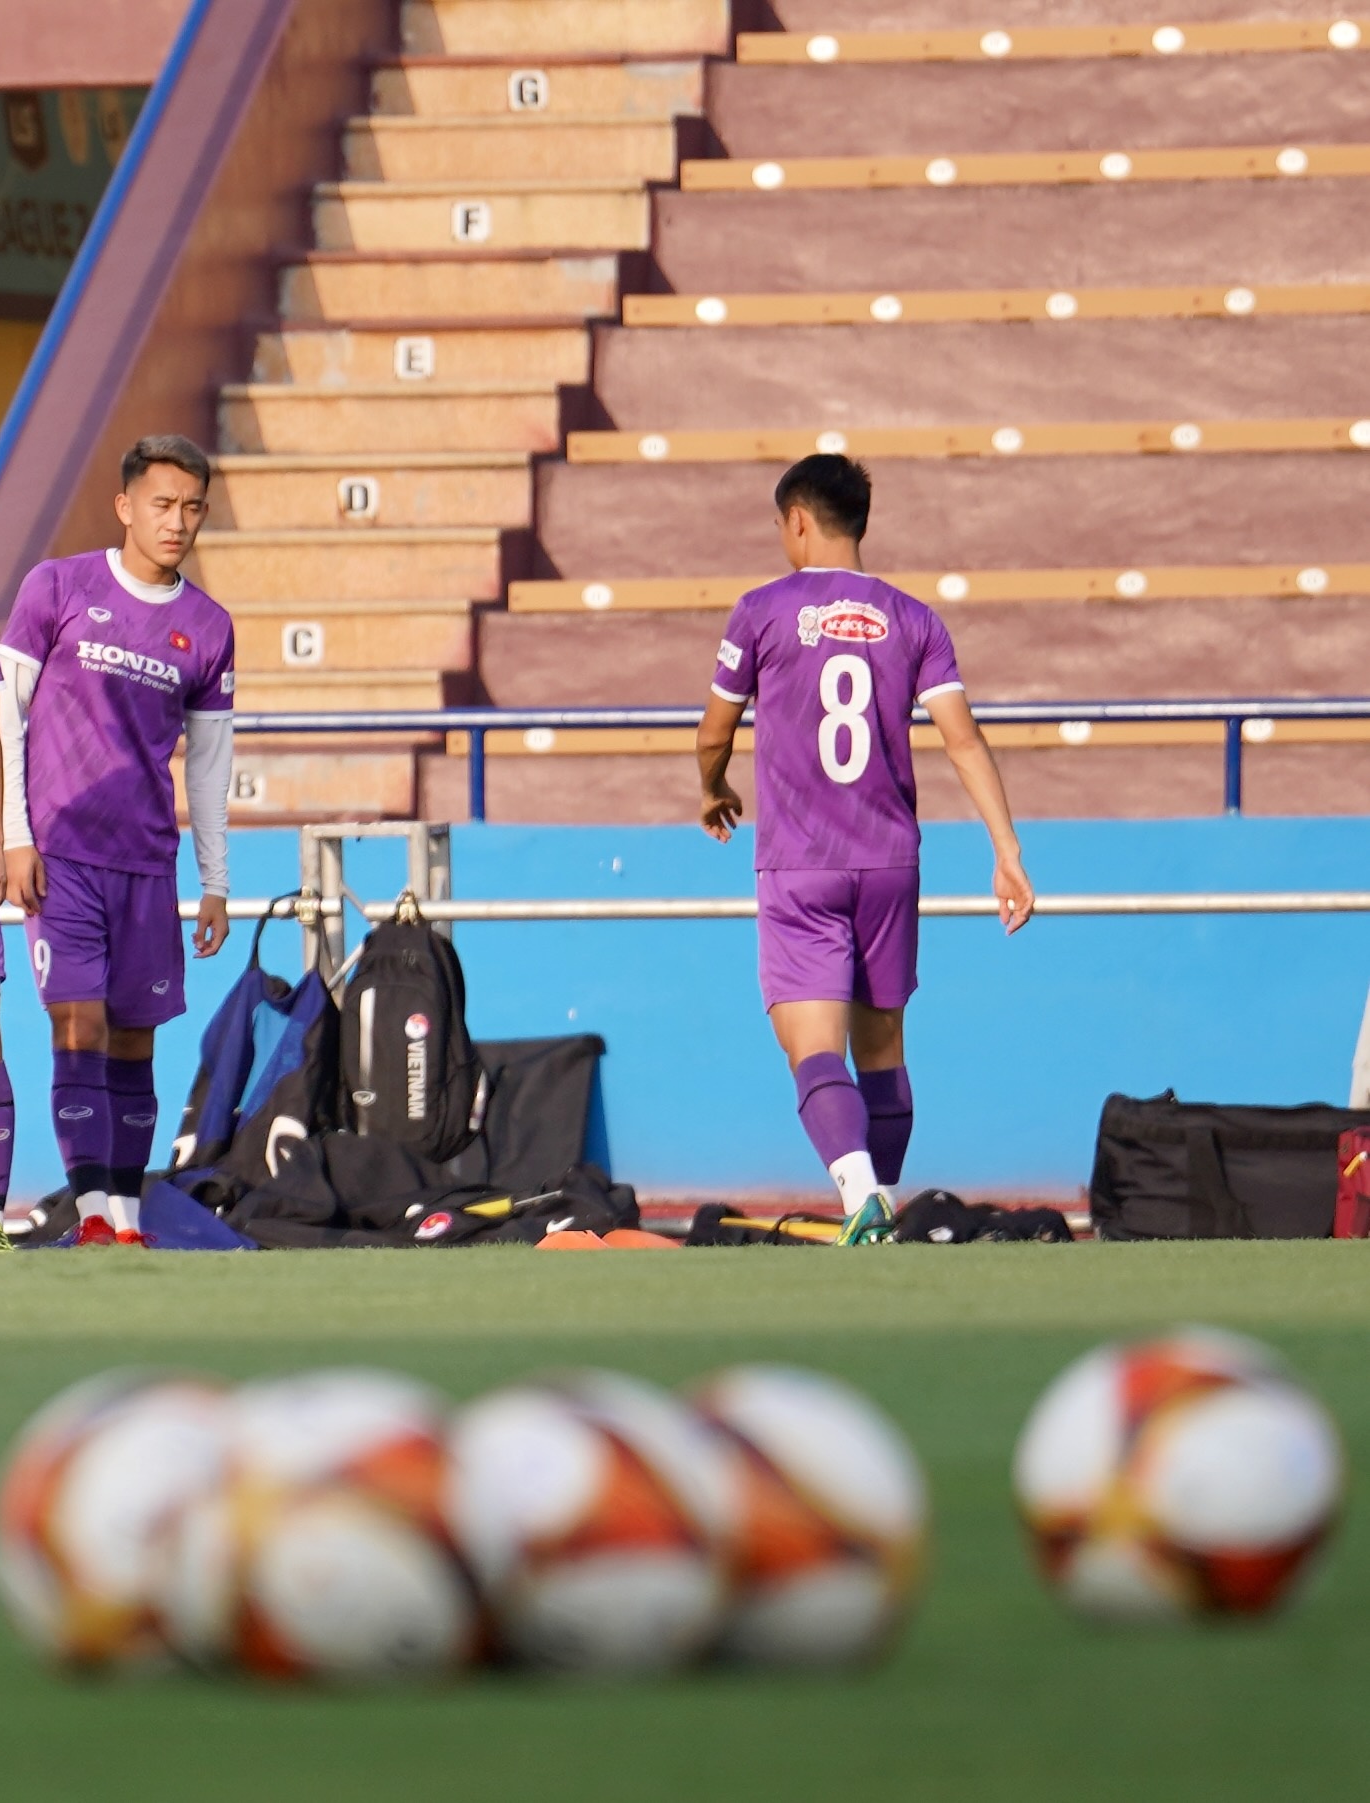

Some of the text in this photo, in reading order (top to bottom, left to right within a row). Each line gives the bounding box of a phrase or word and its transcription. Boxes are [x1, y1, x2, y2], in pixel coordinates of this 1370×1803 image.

[518, 77, 539, 105] G
[463, 207, 481, 236] F
[405, 343, 425, 373] E
[346, 484, 369, 512] D
[292, 628, 313, 657] C
[76, 640, 181, 685] HONDA
[80, 660, 100, 672] The
[129, 673, 142, 683] of
[141, 675, 175, 695] Dreams
[817, 653, 873, 785] 8
[234, 770, 256, 799] B
[33, 939, 51, 989] 9
[407, 1040, 427, 1120] VIETNAM
